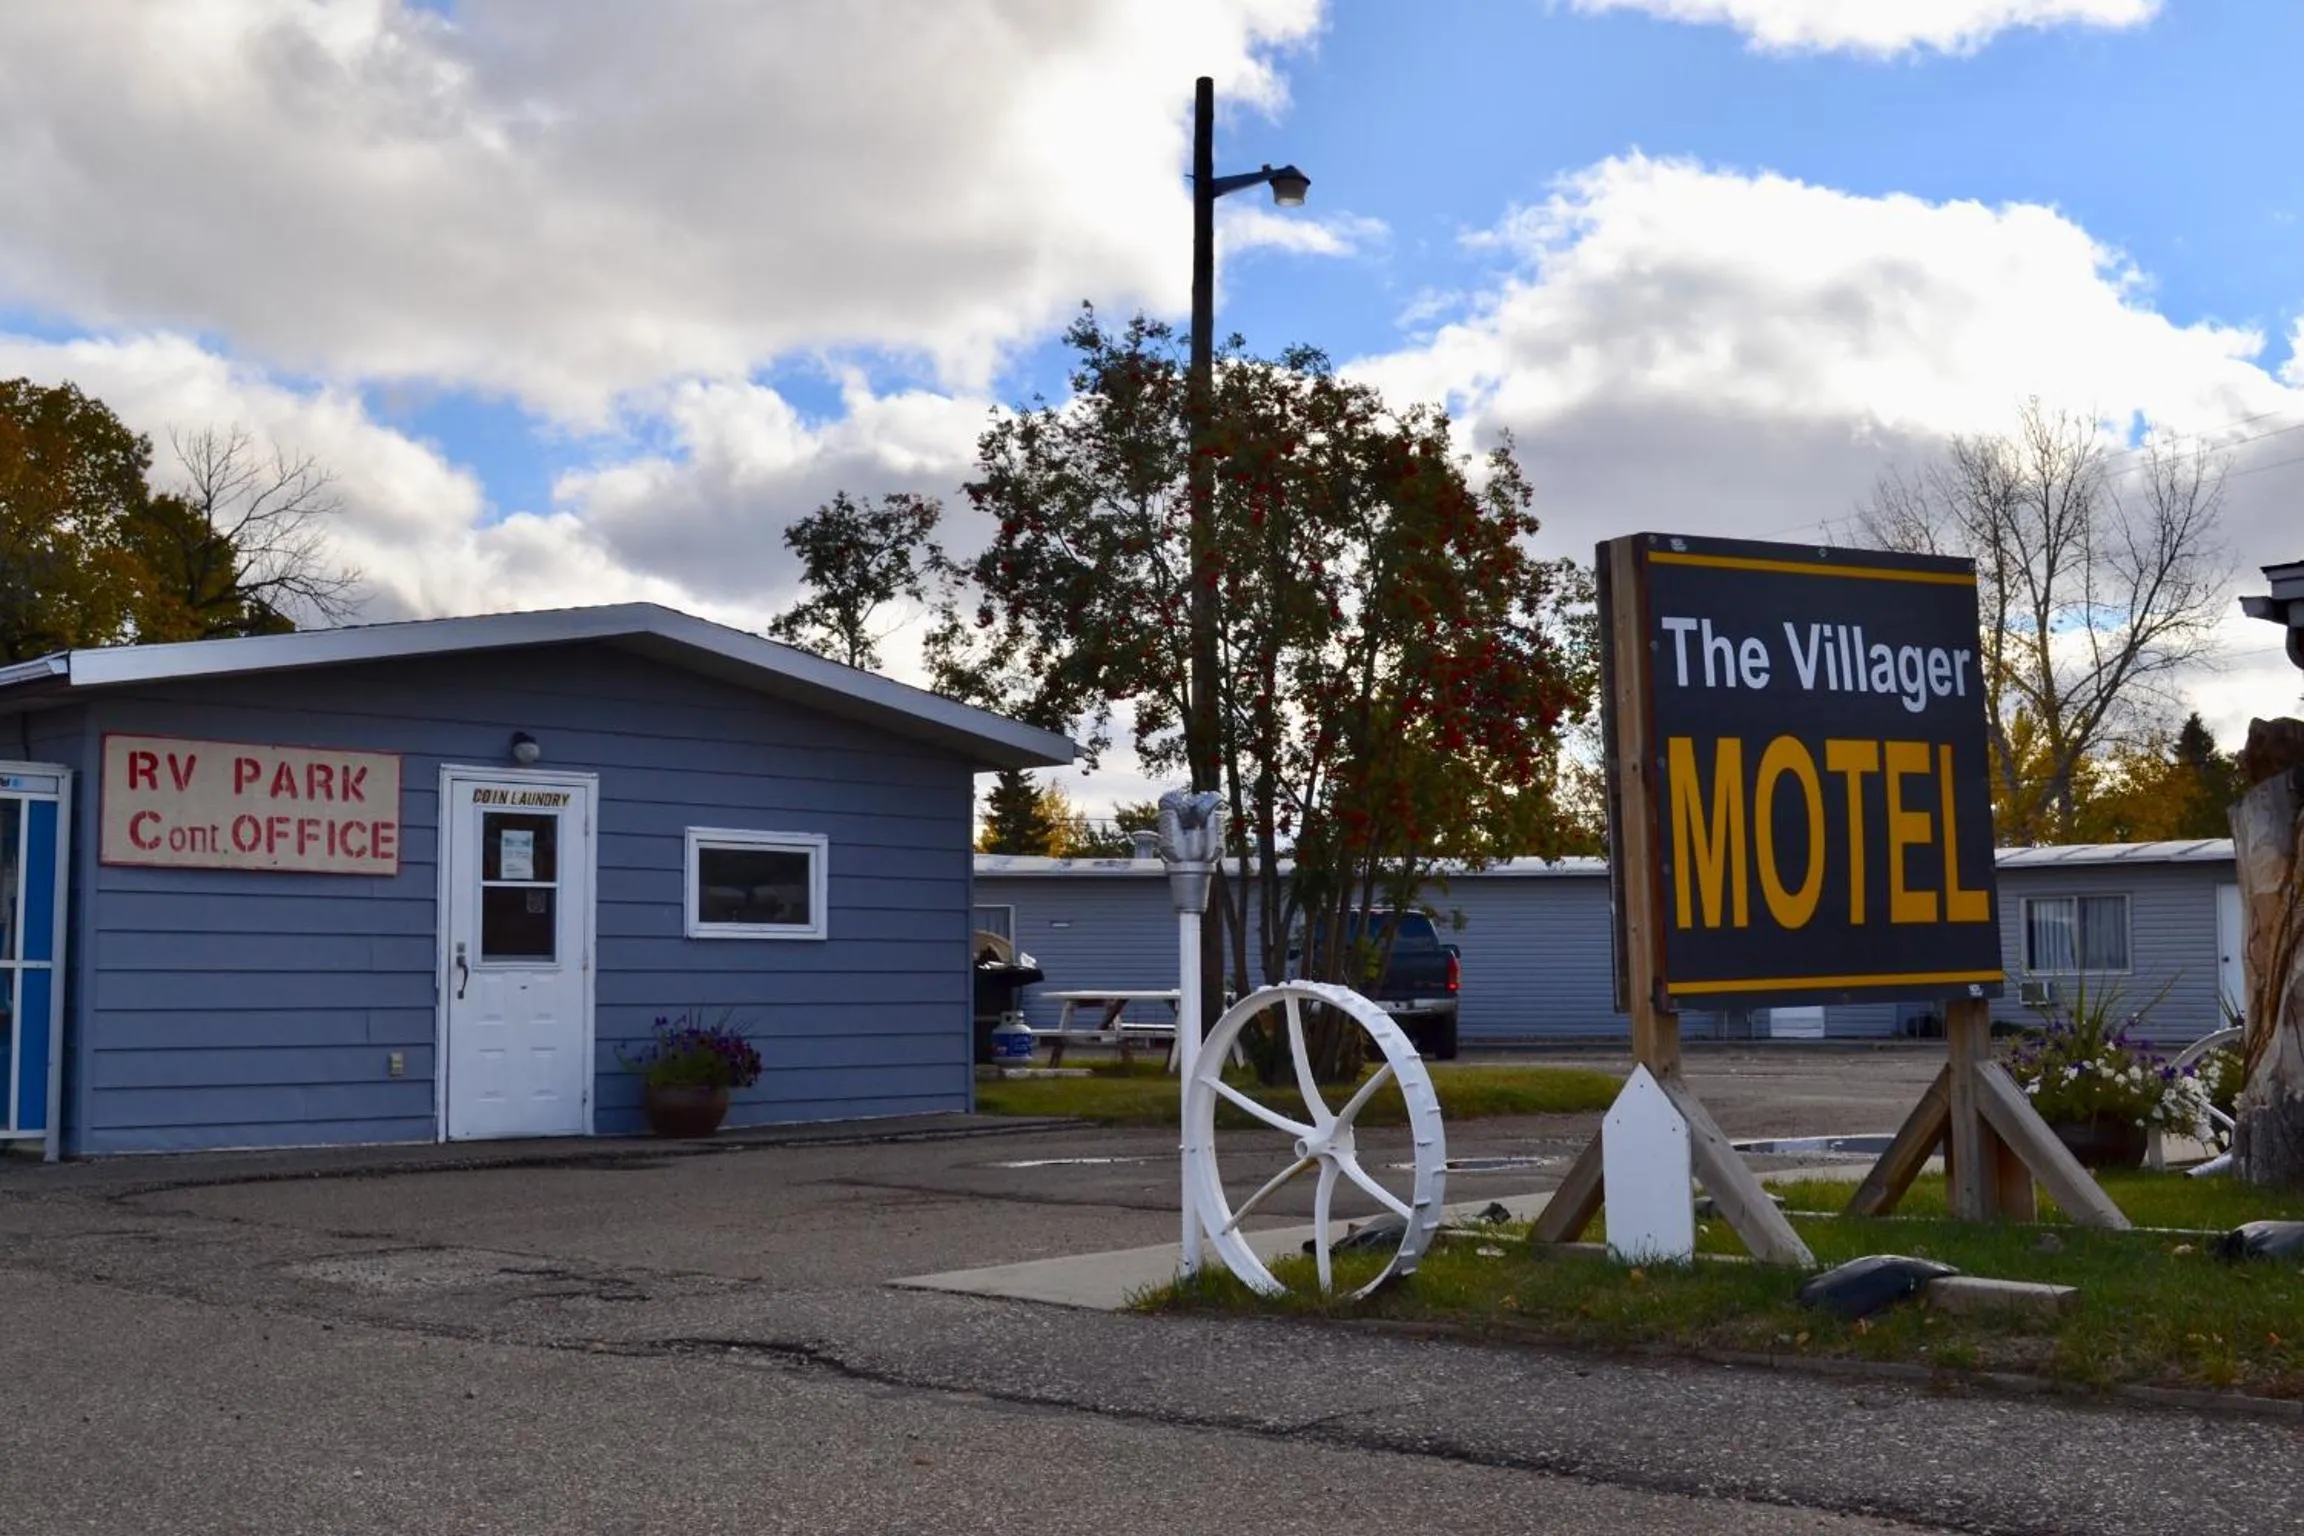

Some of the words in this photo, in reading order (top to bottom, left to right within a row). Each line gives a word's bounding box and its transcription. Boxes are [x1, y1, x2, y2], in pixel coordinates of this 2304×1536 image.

[1661, 616, 1771, 690] The
[1783, 621, 1971, 713] Villager
[128, 751, 197, 792] RV
[233, 756, 368, 802] PARK
[472, 788, 509, 805] COIN
[510, 790, 571, 807] LAUNDRY
[231, 814, 396, 859] OFFICE
[1668, 735, 1990, 929] MOTEL
